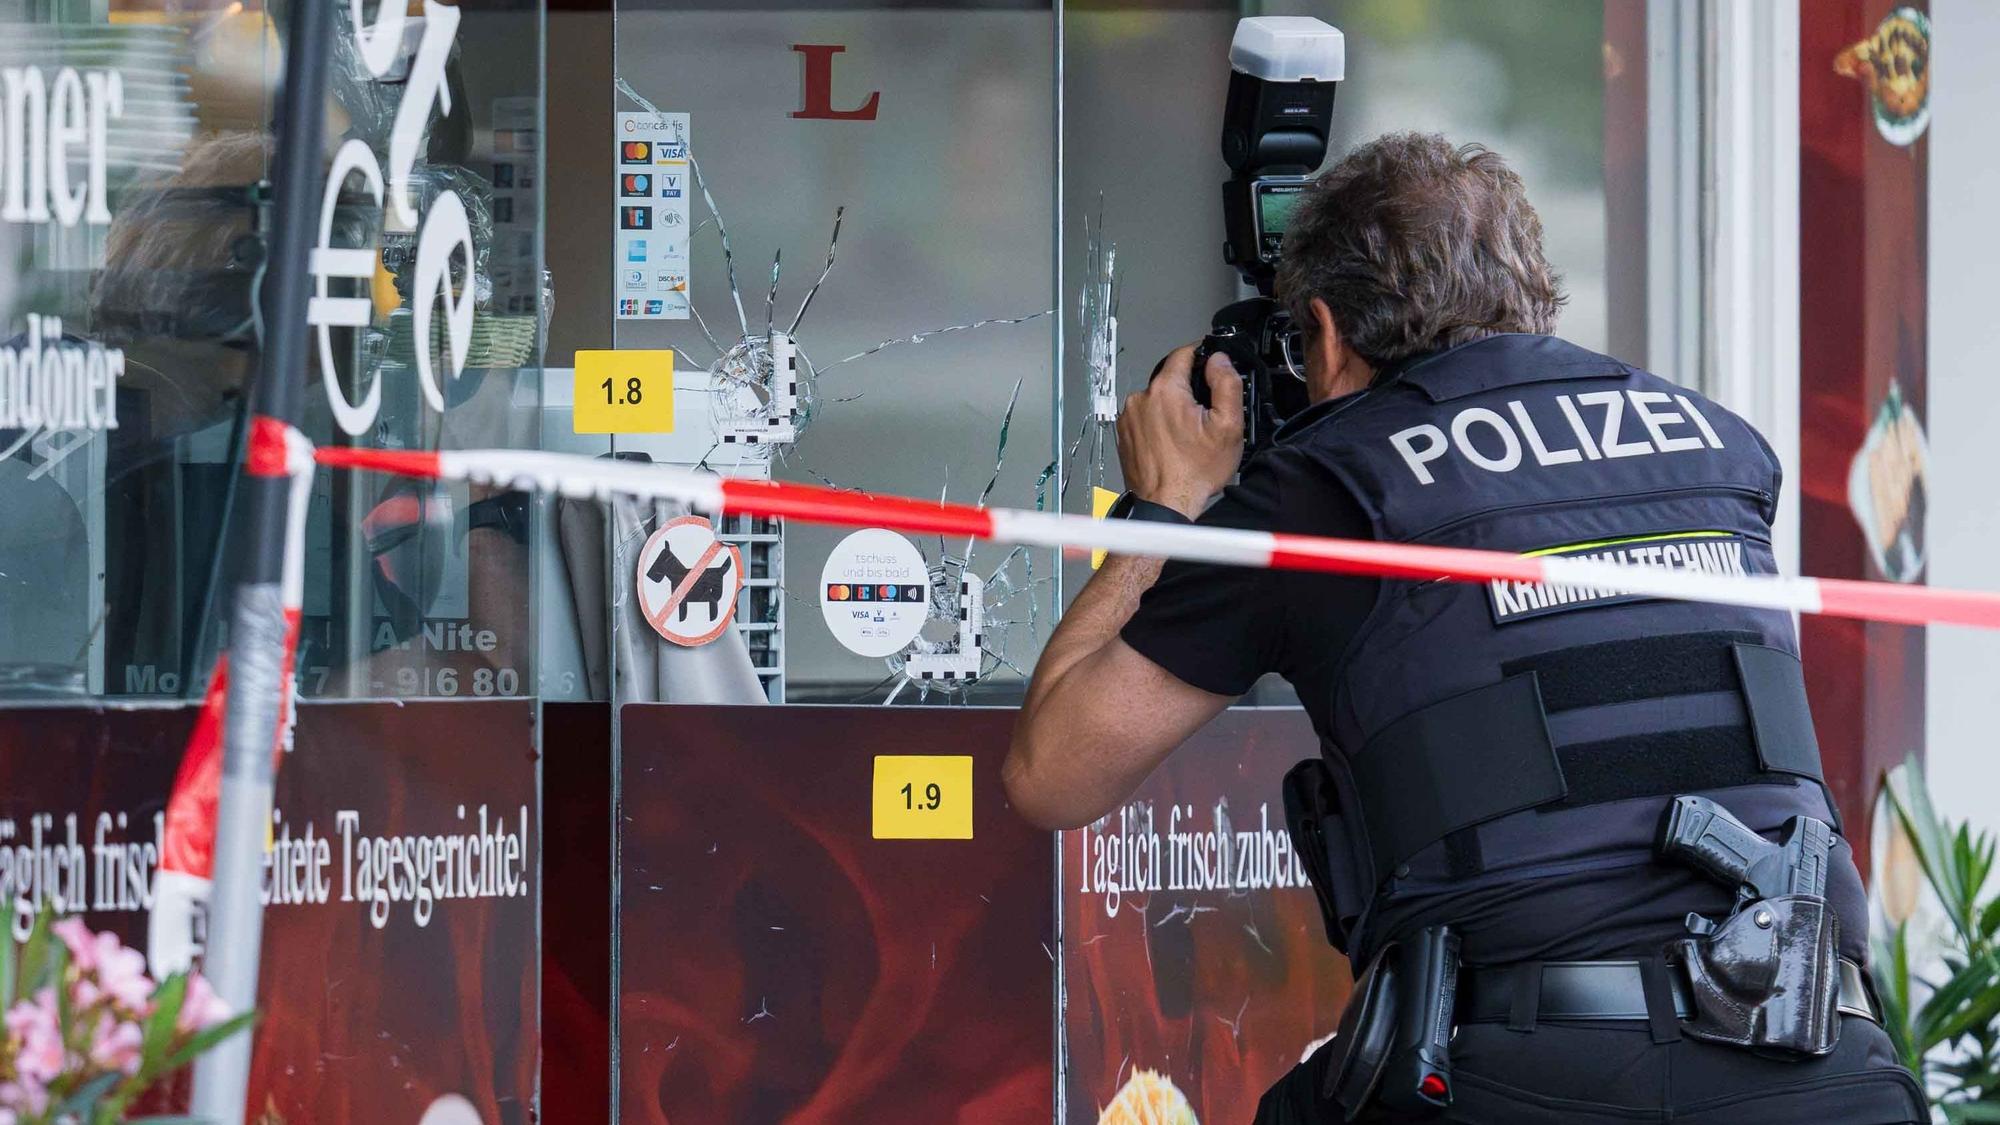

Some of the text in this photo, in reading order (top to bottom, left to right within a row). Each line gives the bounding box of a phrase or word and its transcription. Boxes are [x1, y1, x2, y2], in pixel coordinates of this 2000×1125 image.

[792, 44, 880, 121] L
[0, 65, 124, 228] ner
[661, 148, 684, 158] VISA
[601, 376, 642, 405] 1.8
[1388, 389, 1725, 485] POLIZEI
[843, 567, 910, 578] und bis bald
[852, 610, 870, 619] VISA
[900, 782, 941, 811] 1.9
[335, 803, 528, 929] Tagesgerichte!
[1168, 802, 1230, 891] frisch
